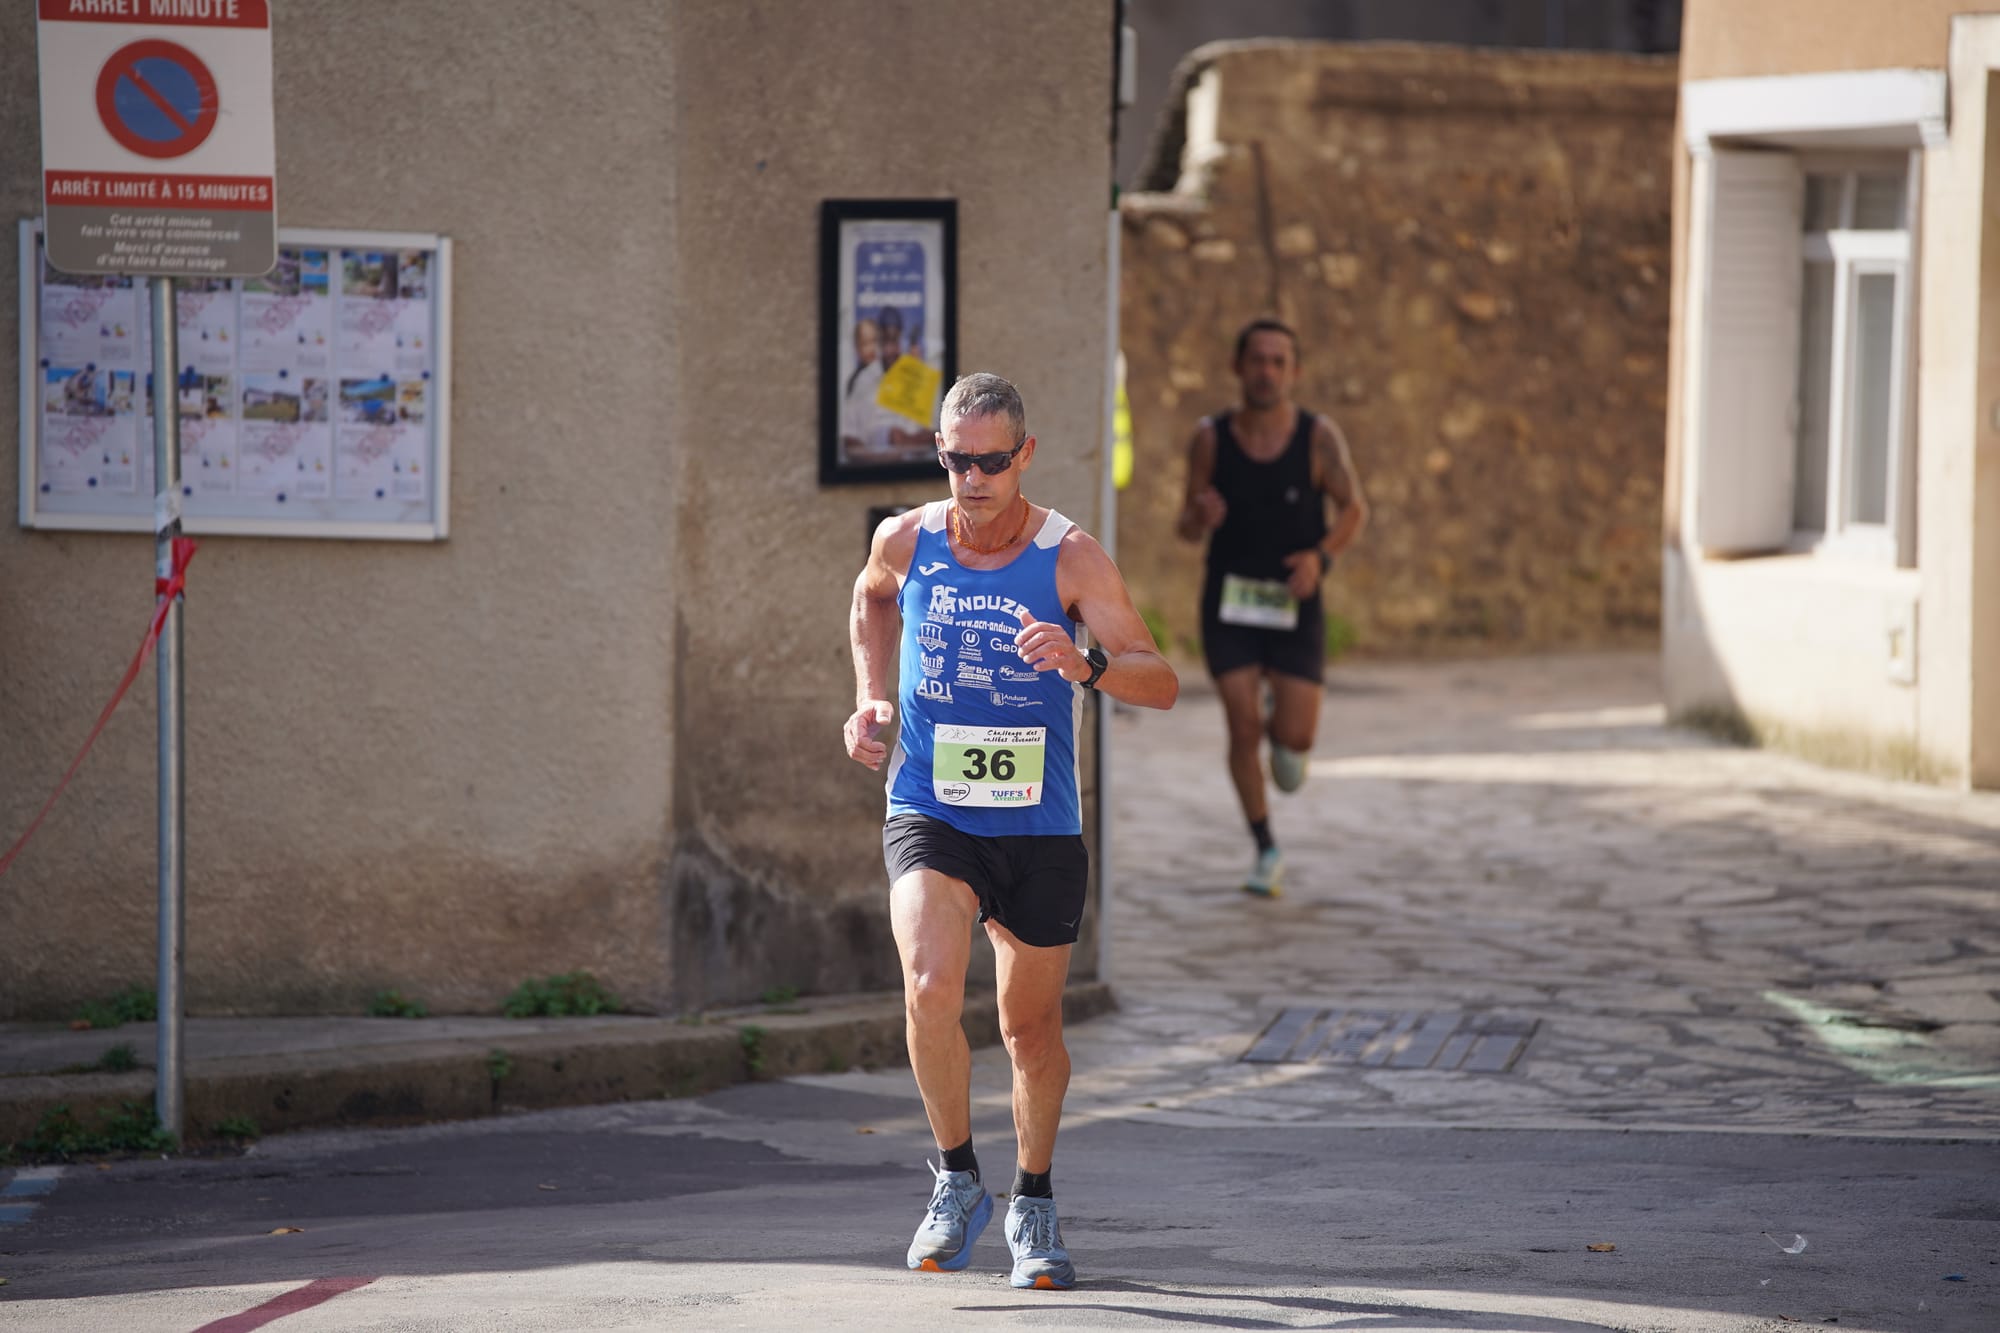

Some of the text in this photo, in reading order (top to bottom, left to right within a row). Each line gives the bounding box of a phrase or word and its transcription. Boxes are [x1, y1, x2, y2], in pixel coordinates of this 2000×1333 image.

[150, 0, 240, 19] MINUTE
[51, 177, 268, 202] ARRÊT LIMITÉ À 15 MINUTES
[110, 213, 212, 228] Cet arrêt minute
[81, 225, 240, 241] fait vivre vos commerces
[113, 241, 210, 256] Merci d'avance
[96, 253, 227, 271] d'en faire bon usage
[987, 729, 1022, 739] Challenge
[961, 748, 1016, 781] 36
